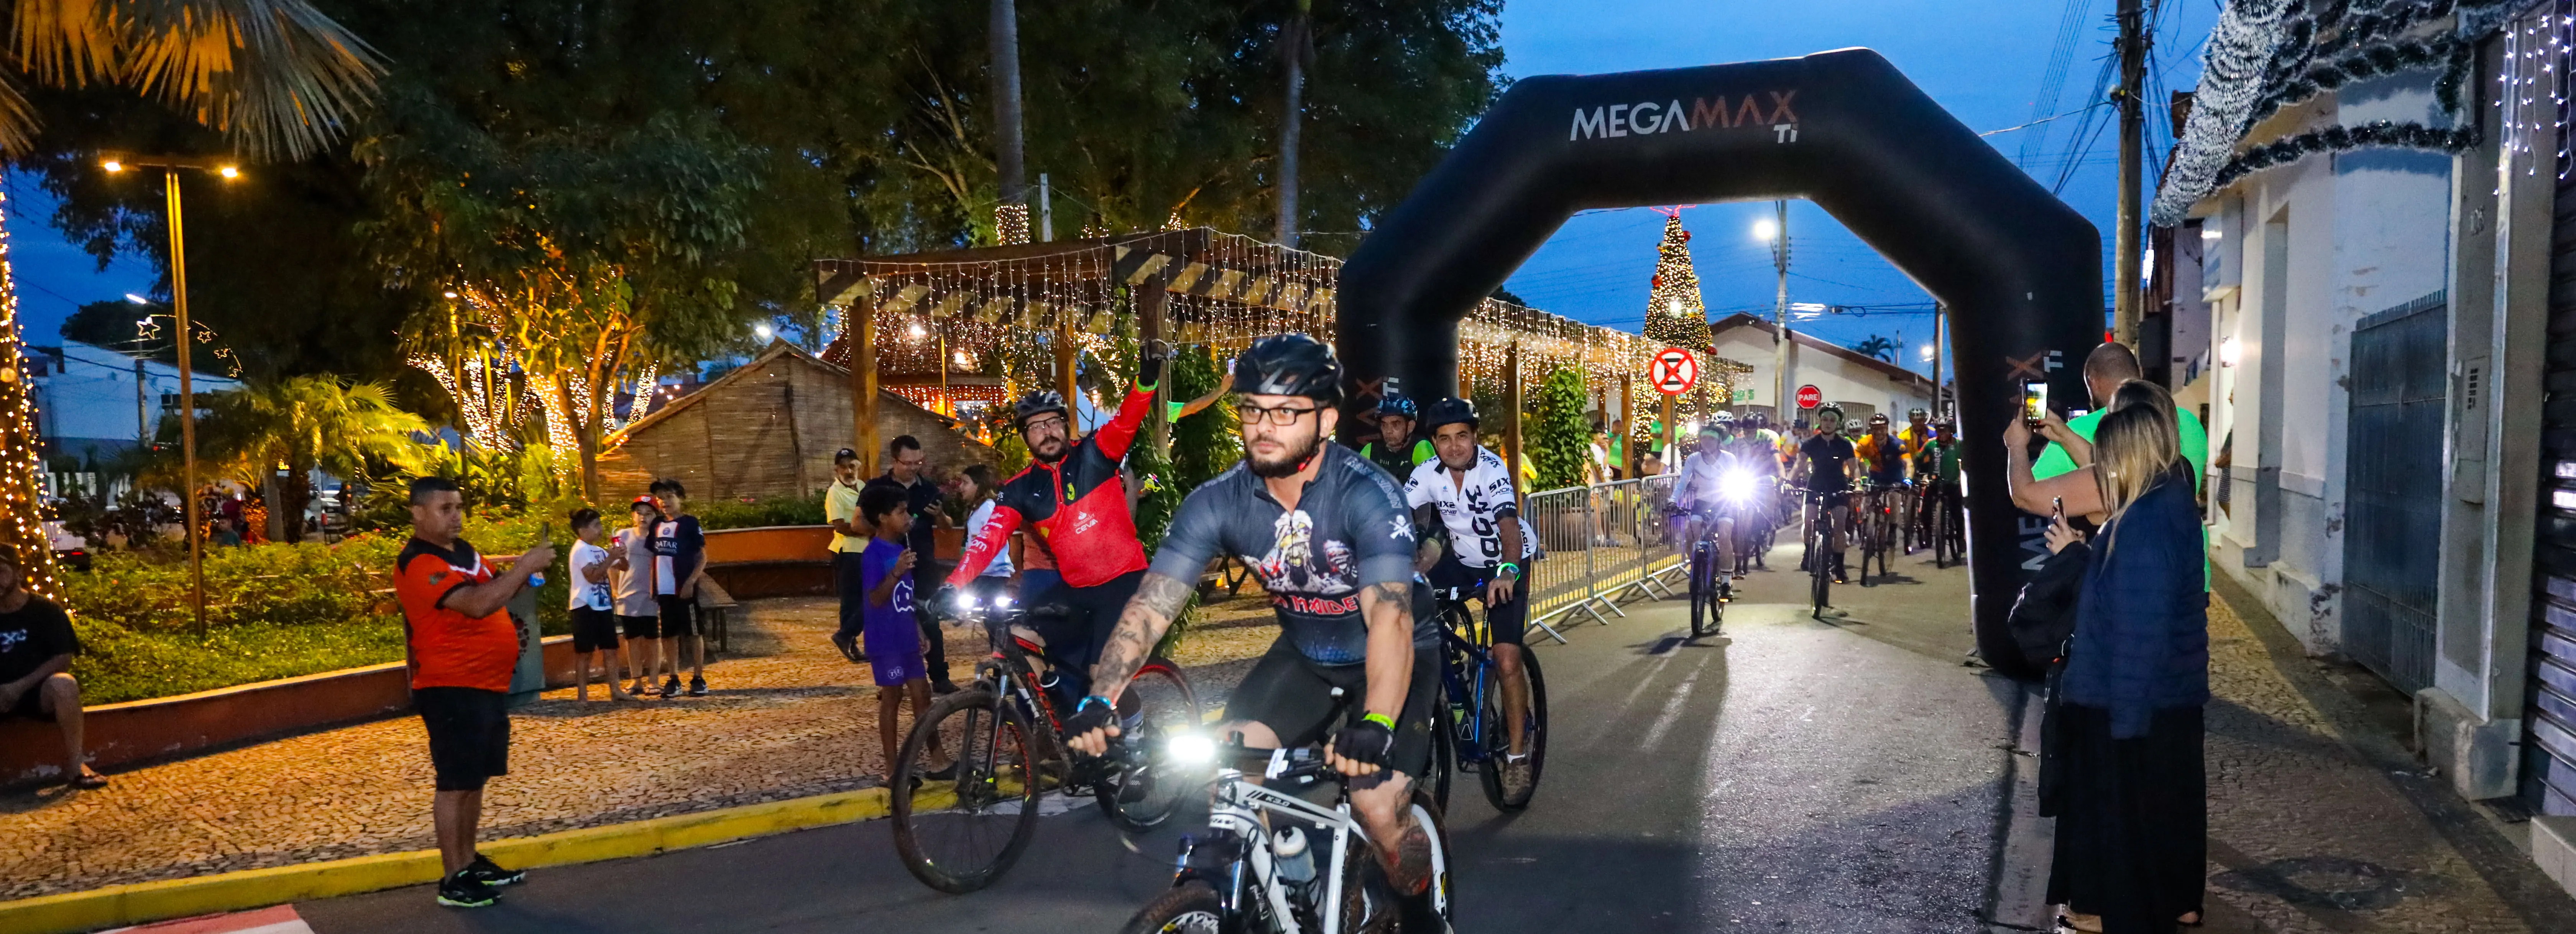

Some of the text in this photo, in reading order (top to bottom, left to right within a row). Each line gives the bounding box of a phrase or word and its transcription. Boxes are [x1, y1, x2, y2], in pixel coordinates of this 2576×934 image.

[1570, 89, 1797, 141] MEGAMAX
[655, 540, 677, 550] QATAR
[1265, 795, 1291, 807] K3.0
